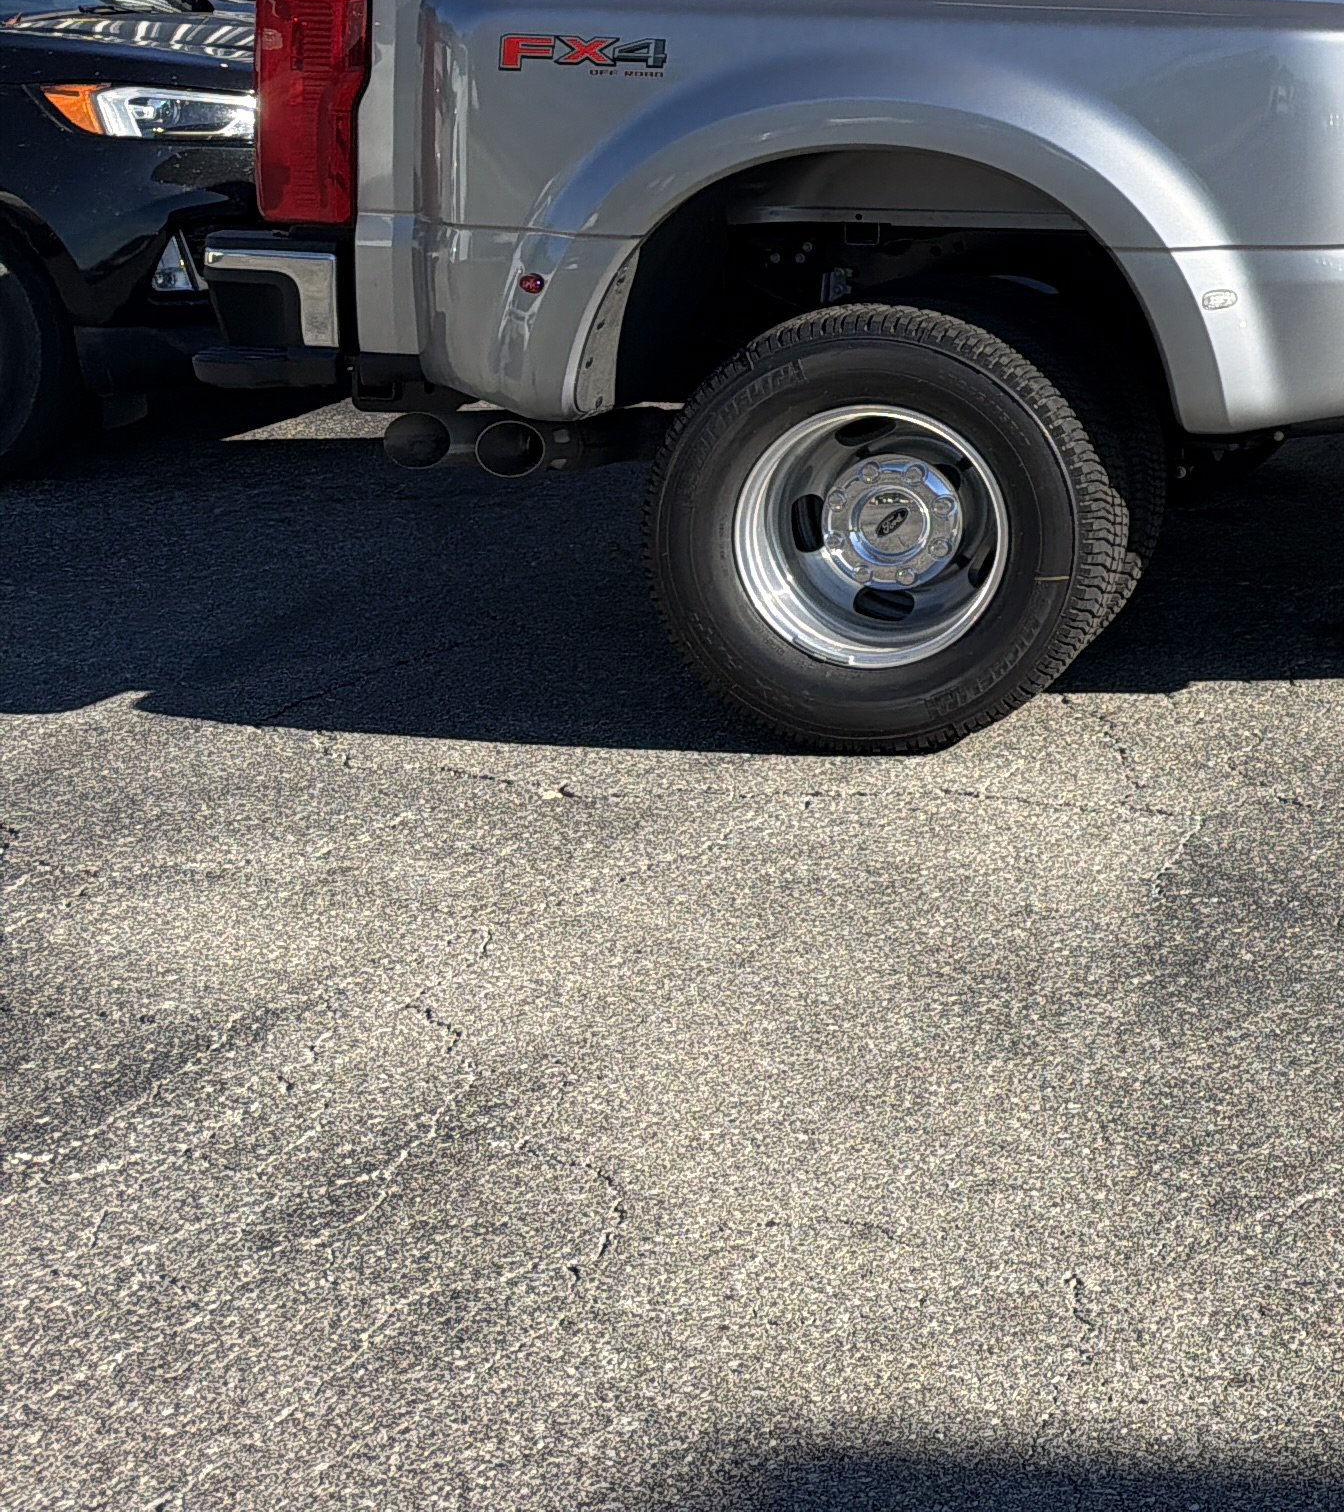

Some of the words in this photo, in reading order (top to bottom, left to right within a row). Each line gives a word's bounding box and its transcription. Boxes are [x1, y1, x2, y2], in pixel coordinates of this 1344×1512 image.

[498, 33, 667, 71] FX4
[589, 69, 618, 77] OFF
[624, 70, 664, 78] ROAD
[880, 511, 904, 535] Ford
